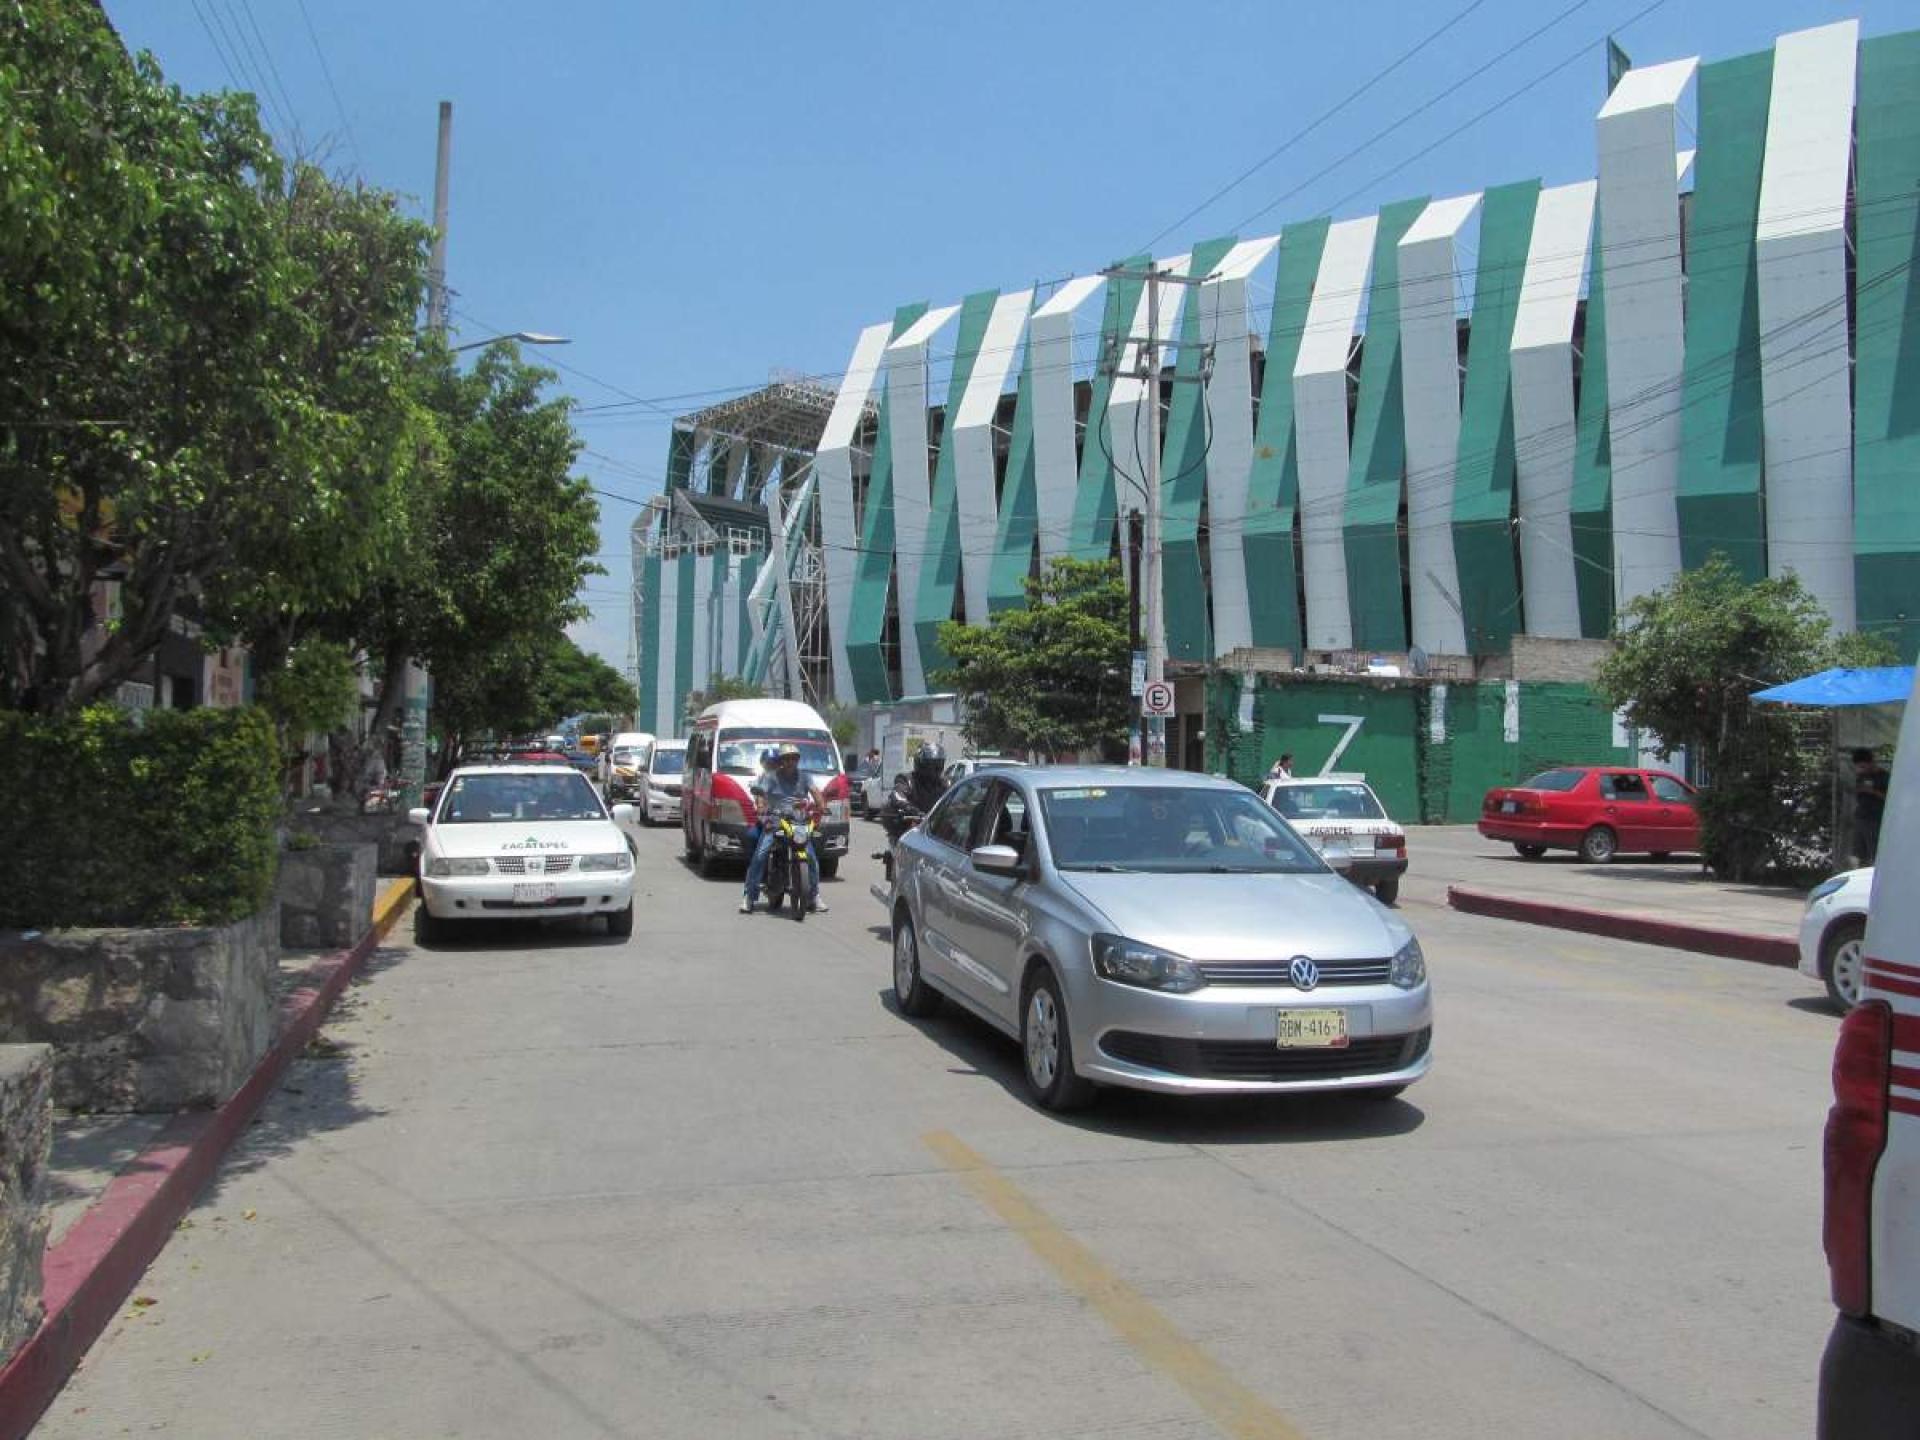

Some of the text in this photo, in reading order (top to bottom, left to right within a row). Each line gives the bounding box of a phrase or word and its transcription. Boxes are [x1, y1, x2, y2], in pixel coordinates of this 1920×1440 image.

[1151, 690, 1164, 706] E
[1309, 826, 1353, 836] ZACATEPEC
[501, 842, 569, 850] ZACATEPEC
